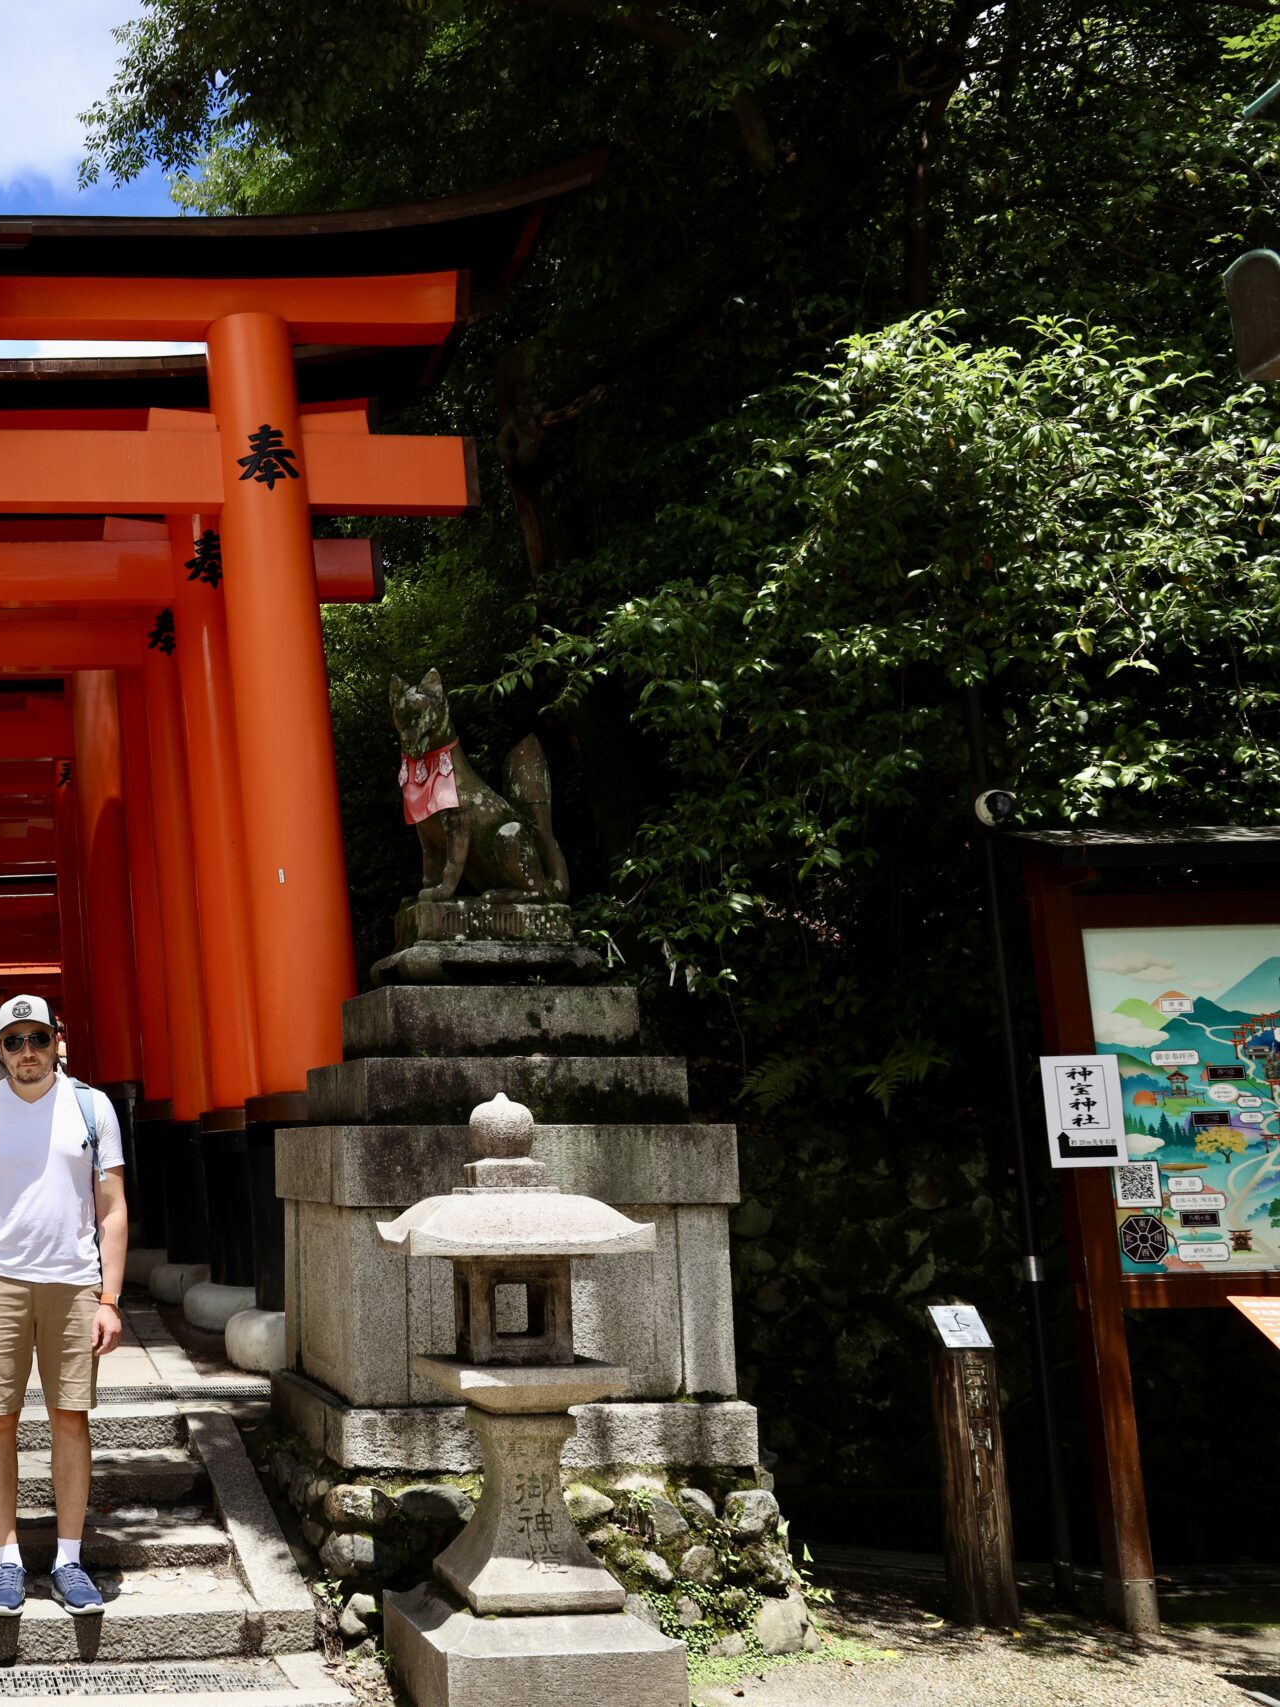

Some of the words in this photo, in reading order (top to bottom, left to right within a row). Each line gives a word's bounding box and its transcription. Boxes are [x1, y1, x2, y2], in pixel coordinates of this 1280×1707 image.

[236, 424, 301, 491] 奉
[1065, 1067, 1100, 1127] 神宝神社
[1124, 1234, 1134, 1243] 北
[1154, 1233, 1163, 1242] 南
[1141, 1248, 1150, 1257] 西
